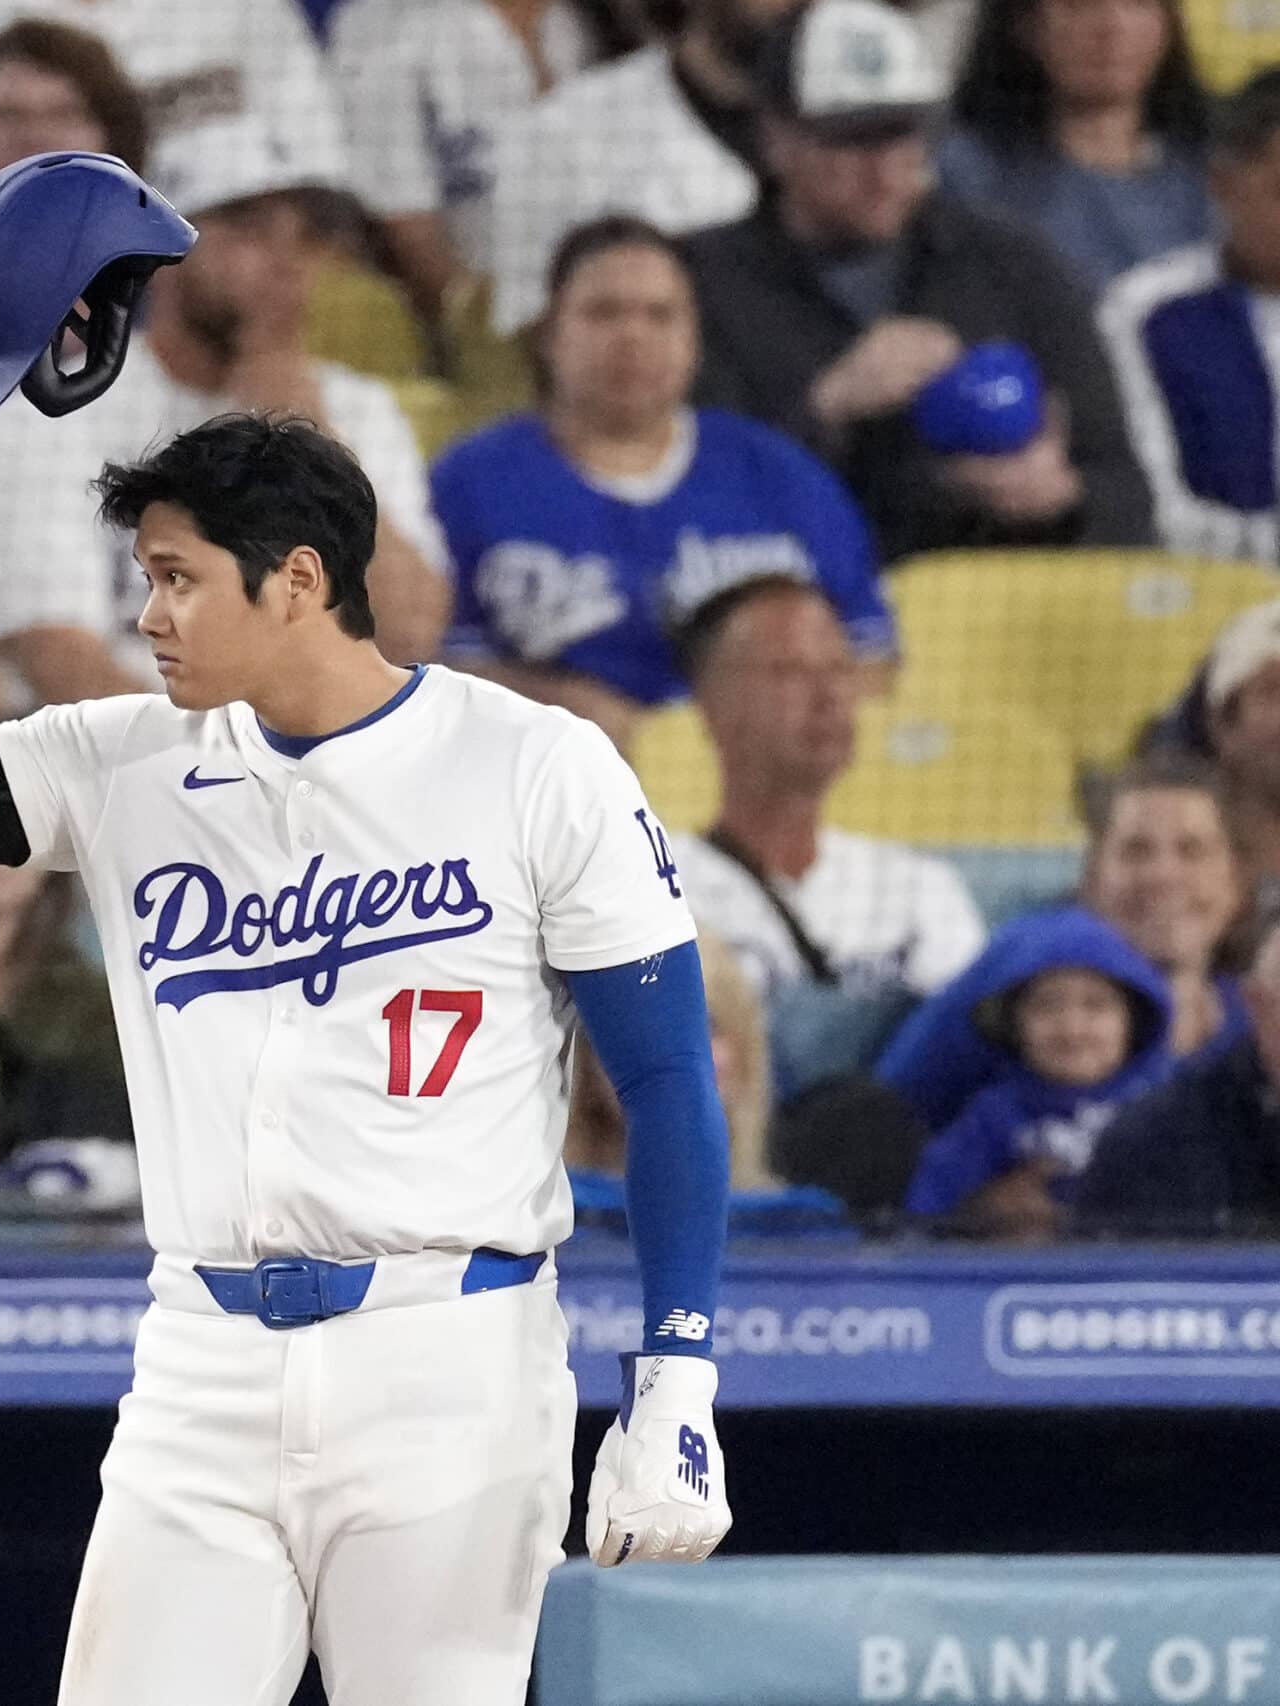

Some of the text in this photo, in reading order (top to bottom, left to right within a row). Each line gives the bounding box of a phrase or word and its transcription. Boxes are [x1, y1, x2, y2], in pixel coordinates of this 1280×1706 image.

[133, 852, 494, 1014] Dodgers
[382, 988, 483, 1097] 17
[1012, 1308, 1280, 1350] DODGERS.C
[859, 1636, 1269, 1701] BANK OF
